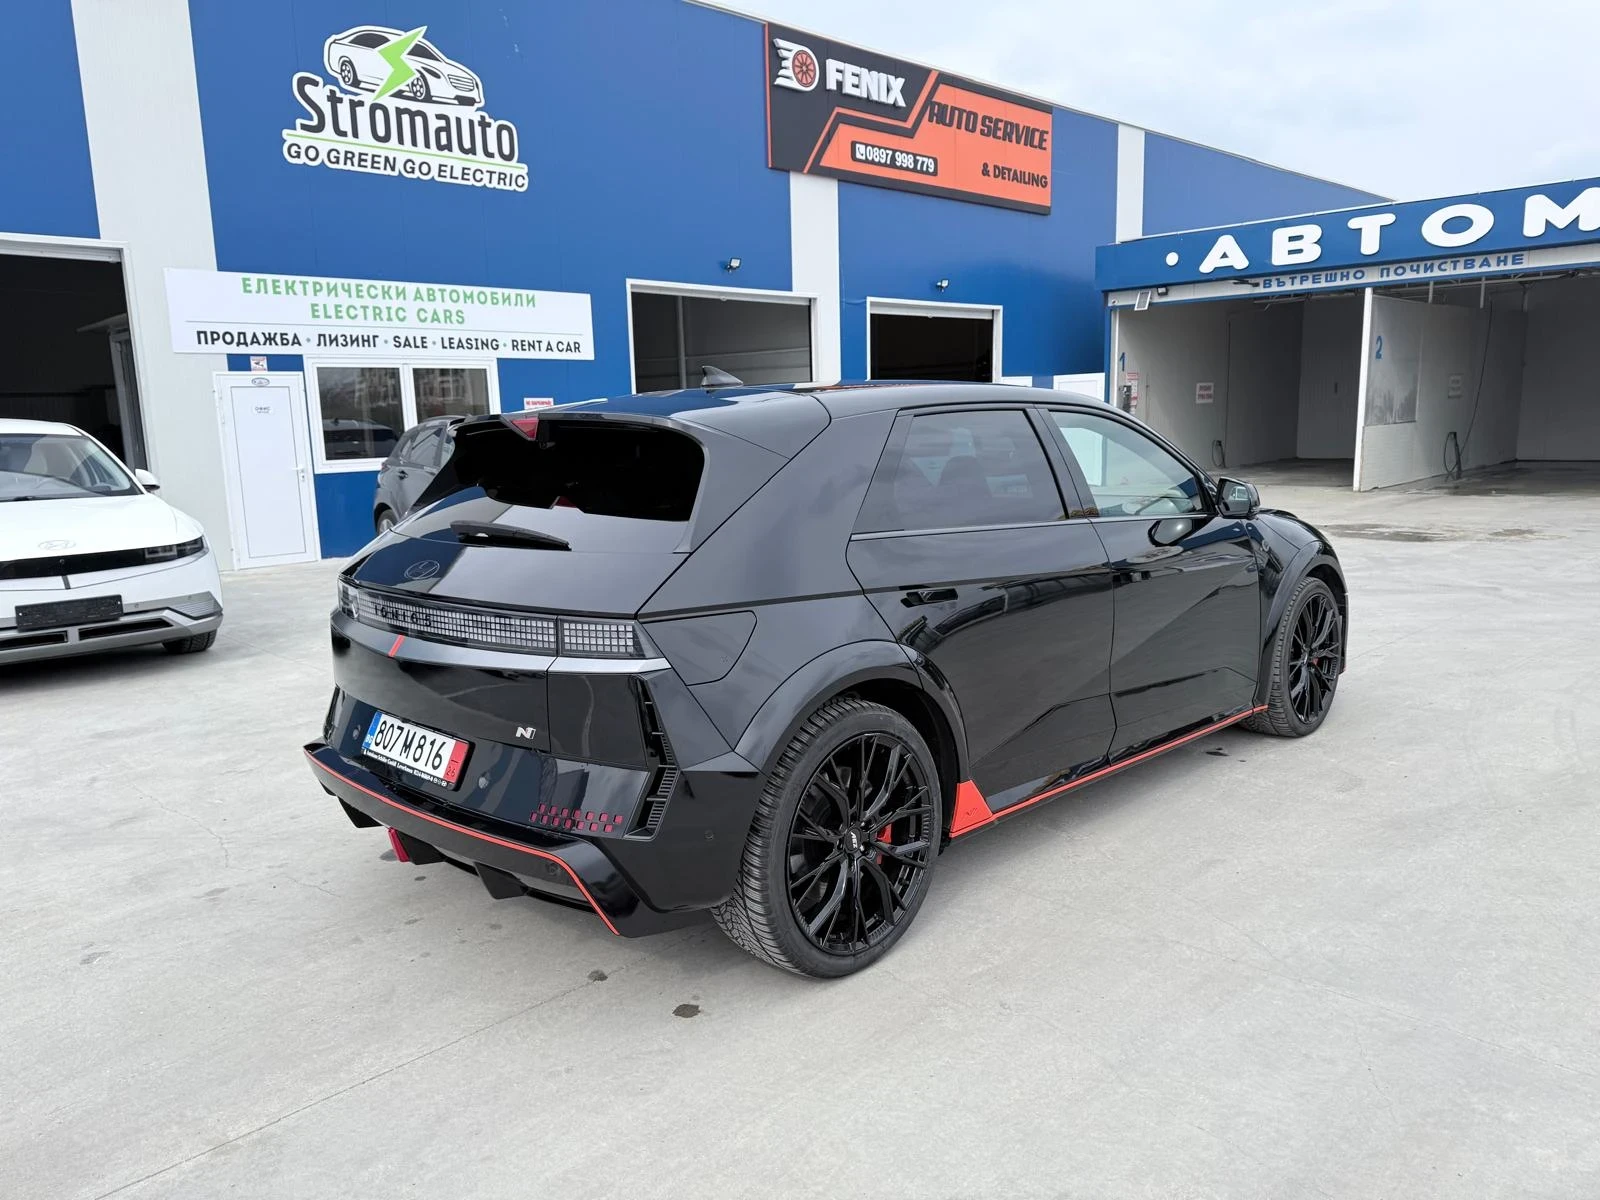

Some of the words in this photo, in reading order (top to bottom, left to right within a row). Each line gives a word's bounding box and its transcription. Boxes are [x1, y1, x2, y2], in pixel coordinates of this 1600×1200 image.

[826, 58, 906, 107] FENIX
[296, 75, 515, 162] Stromauto
[927, 100, 978, 133] AUTO
[980, 114, 1049, 151] SERVICE
[287, 143, 319, 162] GO
[327, 148, 396, 172] GREEN
[403, 159, 431, 176] GO
[437, 163, 526, 188] ELECTRIC
[866, 145, 892, 164] 0897
[895, 151, 914, 169] 998
[916, 156, 935, 173] 779
[982, 162, 990, 177] &
[993, 164, 1048, 188] DETAILING
[1199, 186, 1600, 274] АВТОМ
[1262, 268, 1366, 289] ВЪТРЕШНО
[1379, 253, 1525, 278] ПОЧИСТВАНЕ
[241, 277, 407, 301] ЕЛЕКТРИЧЕСКИ
[413, 286, 536, 308] АВТОМОБИЛИ
[310, 303, 407, 323] ELECTRIC
[416, 308, 465, 325] CARS
[196, 330, 302, 348] ПРОДАЖБА
[316, 333, 379, 348] ЛИЗИНГ
[393, 335, 428, 349] SALE
[441, 336, 499, 351] LEASING
[511, 339, 542, 352] RENT
[546, 340, 554, 352] A
[556, 341, 581, 353] CAR
[1374, 335, 1383, 359] 2
